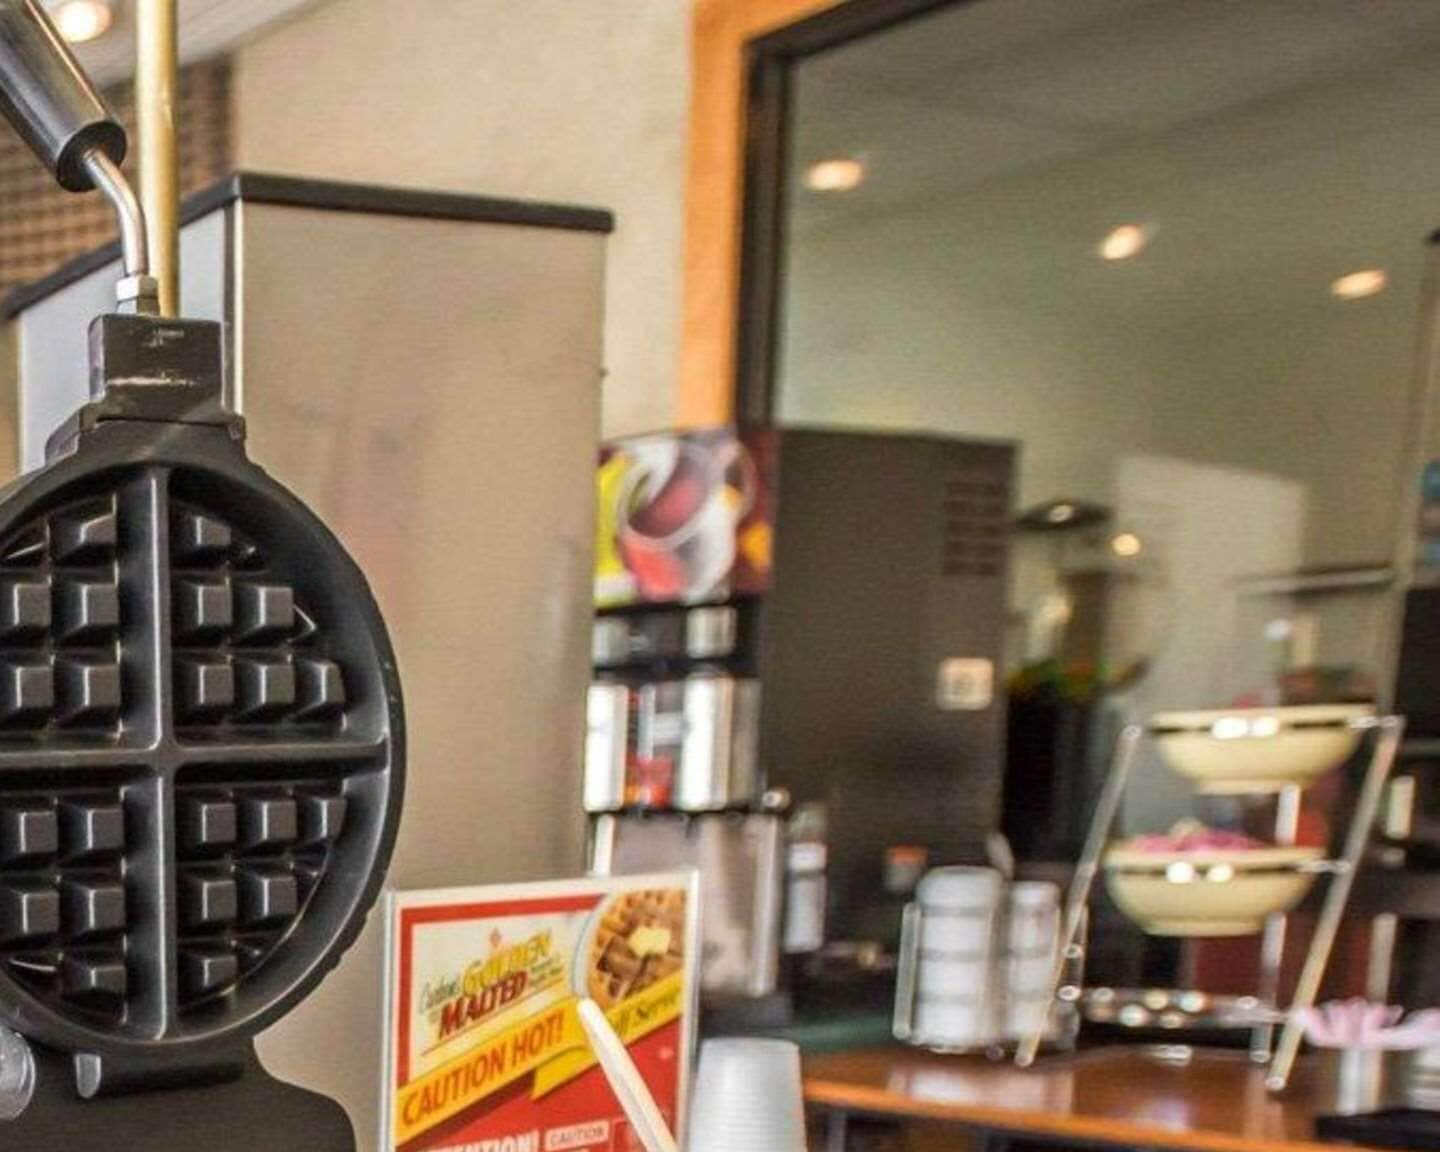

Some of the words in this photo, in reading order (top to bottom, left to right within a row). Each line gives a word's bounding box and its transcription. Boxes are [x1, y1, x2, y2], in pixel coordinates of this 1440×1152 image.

[439, 970, 528, 1041] MALTED
[402, 1042, 508, 1126] CAUTION
[511, 1008, 565, 1068] HOT!
